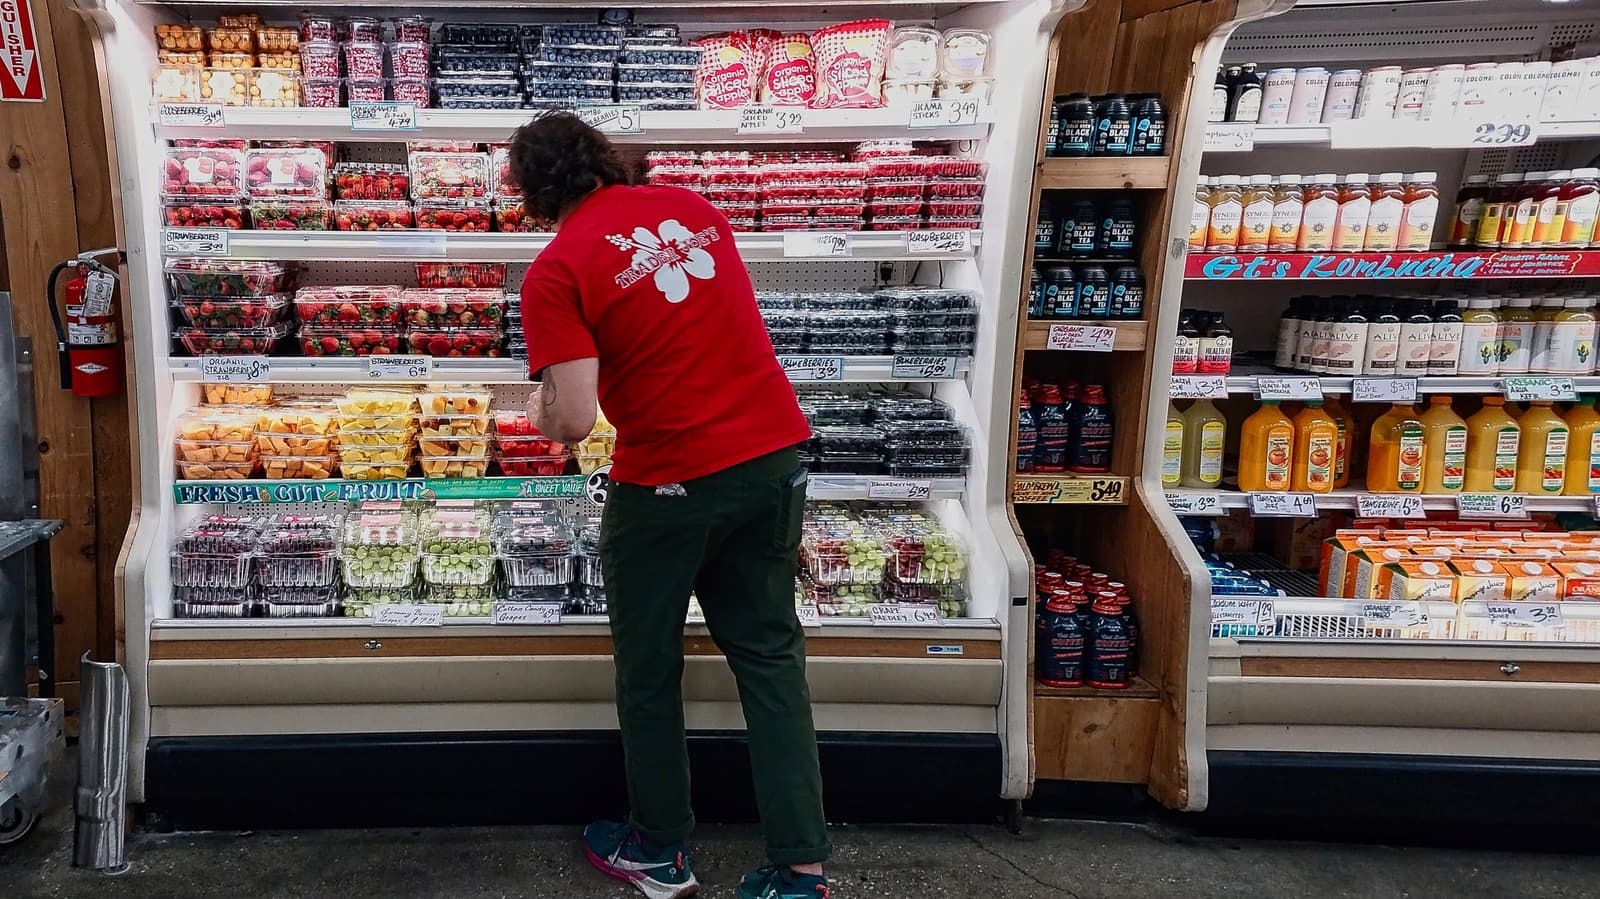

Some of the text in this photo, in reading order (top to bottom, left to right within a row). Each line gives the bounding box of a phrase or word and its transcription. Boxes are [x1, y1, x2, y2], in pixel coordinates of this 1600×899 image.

[913, 102, 943, 112] JICAMA
[166, 232, 220, 241] STRAWBERRIES
[909, 231, 965, 242] RASPBERRIES
[615, 227, 721, 288] TRADER JOE'S
[1300, 253, 1485, 279] Kombucha
[209, 358, 247, 366] ORGANIC
[371, 358, 425, 366] STRAWBERRIES
[783, 358, 835, 368] BLUEBERRIES
[895, 356, 948, 366] BLUEBERRIES
[179, 481, 427, 504] FRESH CUT FRUIT
[535, 483, 560, 494] SWEET
[1360, 501, 1400, 509] TANGERINE
